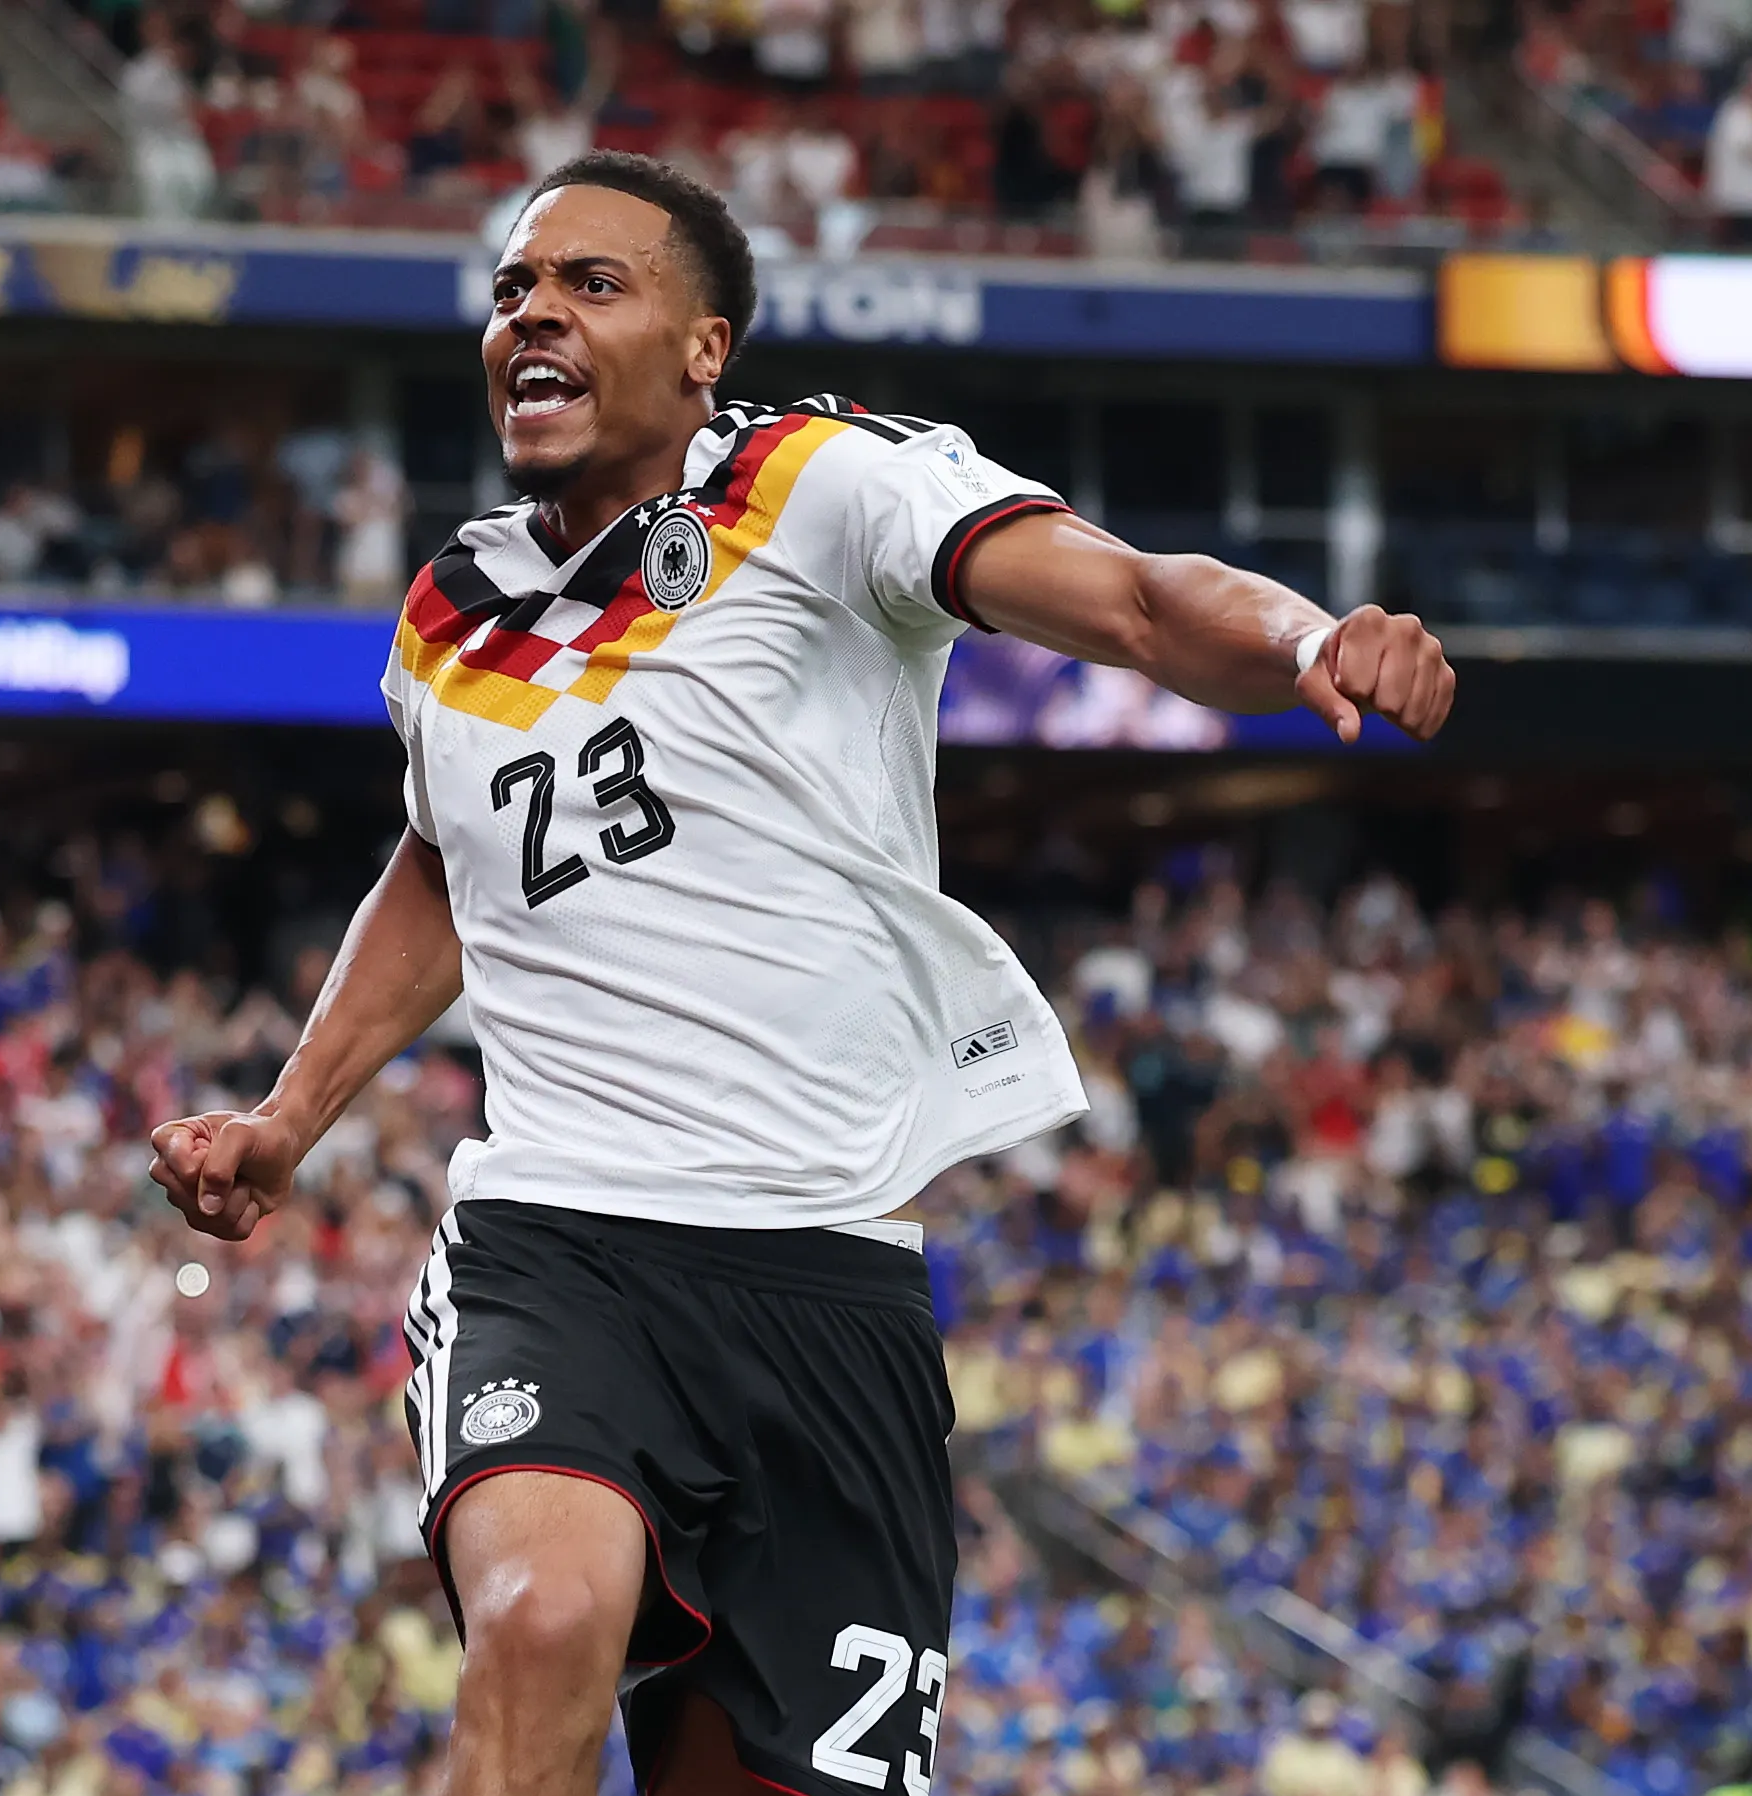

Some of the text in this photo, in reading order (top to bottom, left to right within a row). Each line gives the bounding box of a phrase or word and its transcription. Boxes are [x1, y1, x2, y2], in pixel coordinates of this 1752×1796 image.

[656, 525, 691, 549] DEUTSCHER
[655, 564, 698, 598] FUSSBALL-BUND
[491, 716, 676, 910] 23
